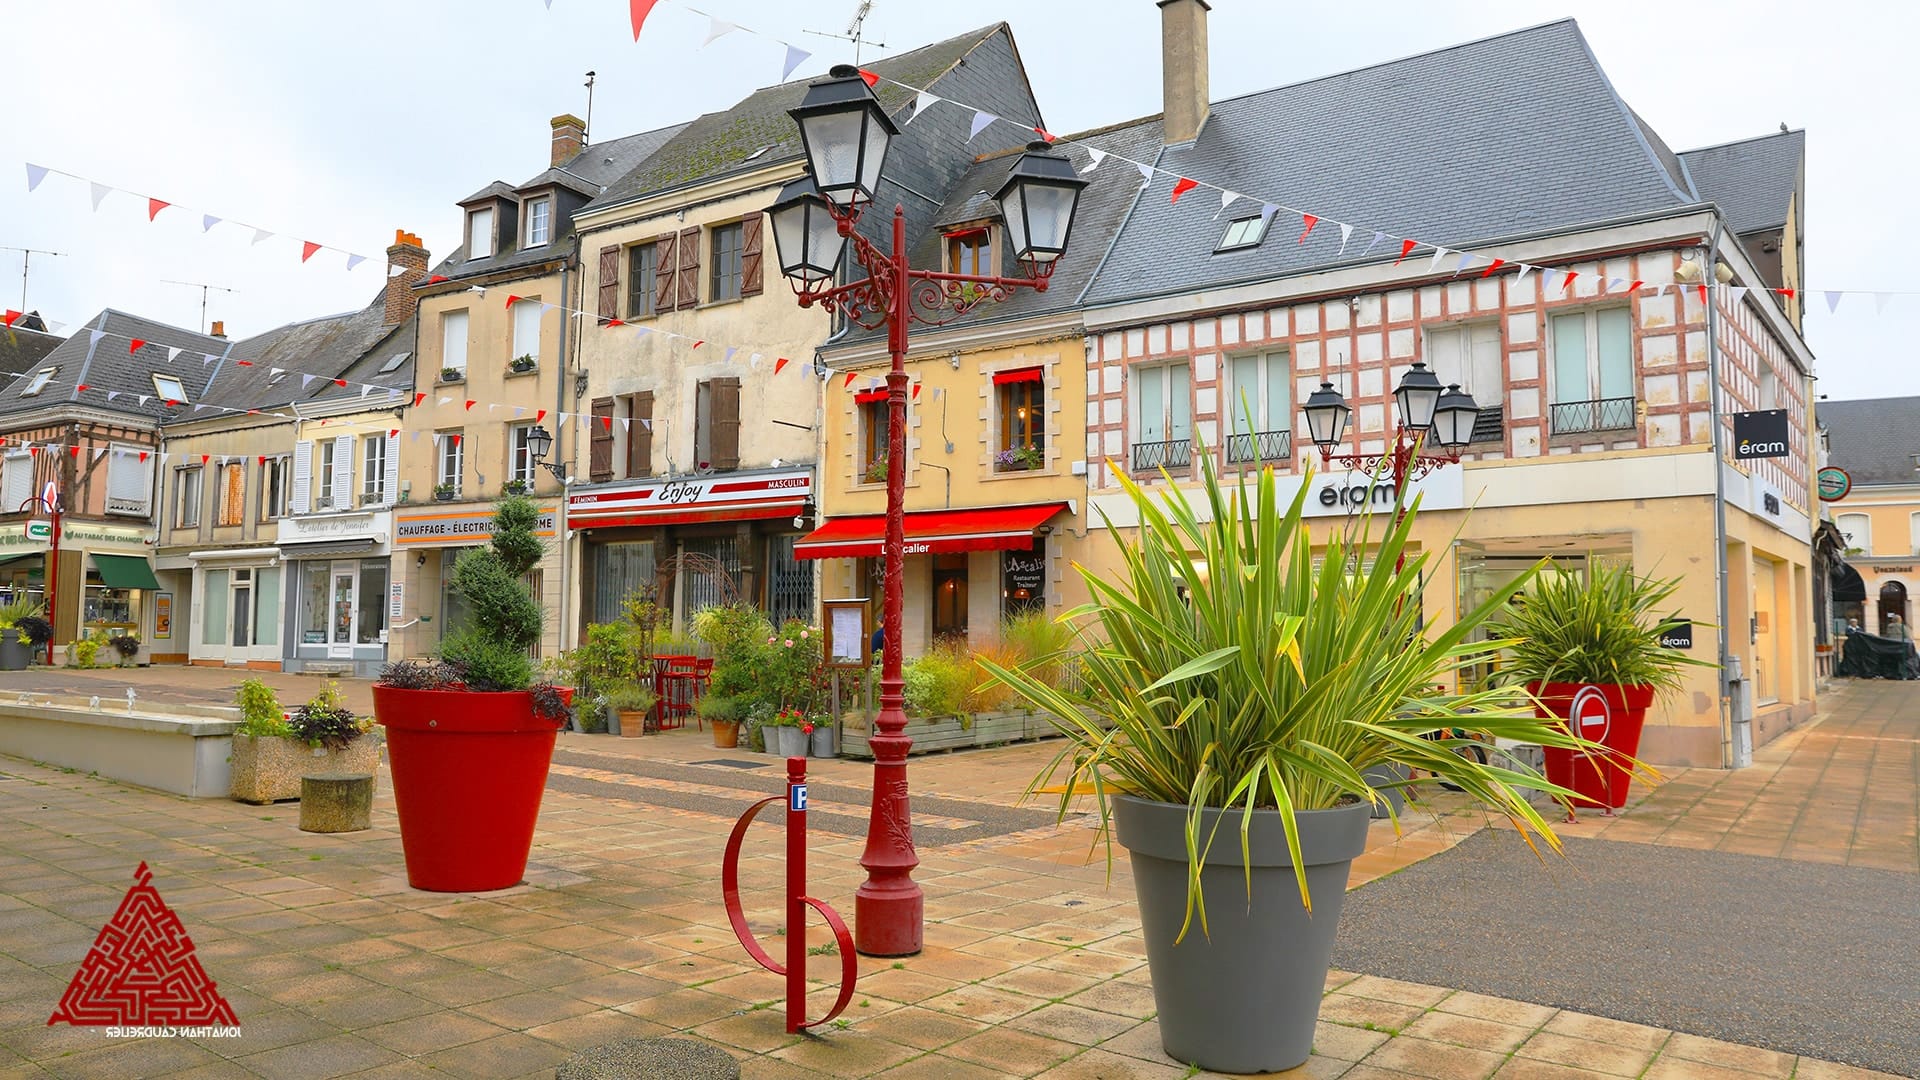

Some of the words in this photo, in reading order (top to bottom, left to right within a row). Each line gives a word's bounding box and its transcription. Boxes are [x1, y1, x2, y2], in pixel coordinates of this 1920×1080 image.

[1739, 439, 1785, 455] éram
[768, 478, 805, 489] MASCULIN
[659, 481, 703, 504] Enjoy
[330, 520, 338, 531] de
[340, 519, 369, 534] Jennifer
[398, 523, 445, 536] CHAUFFAGE
[453, 520, 498, 533] ÉLECTRICI
[84, 532, 103, 540] TABAC
[881, 543, 930, 555] Lcalier
[1662, 636, 1690, 646] éram
[797, 788, 807, 809] P
